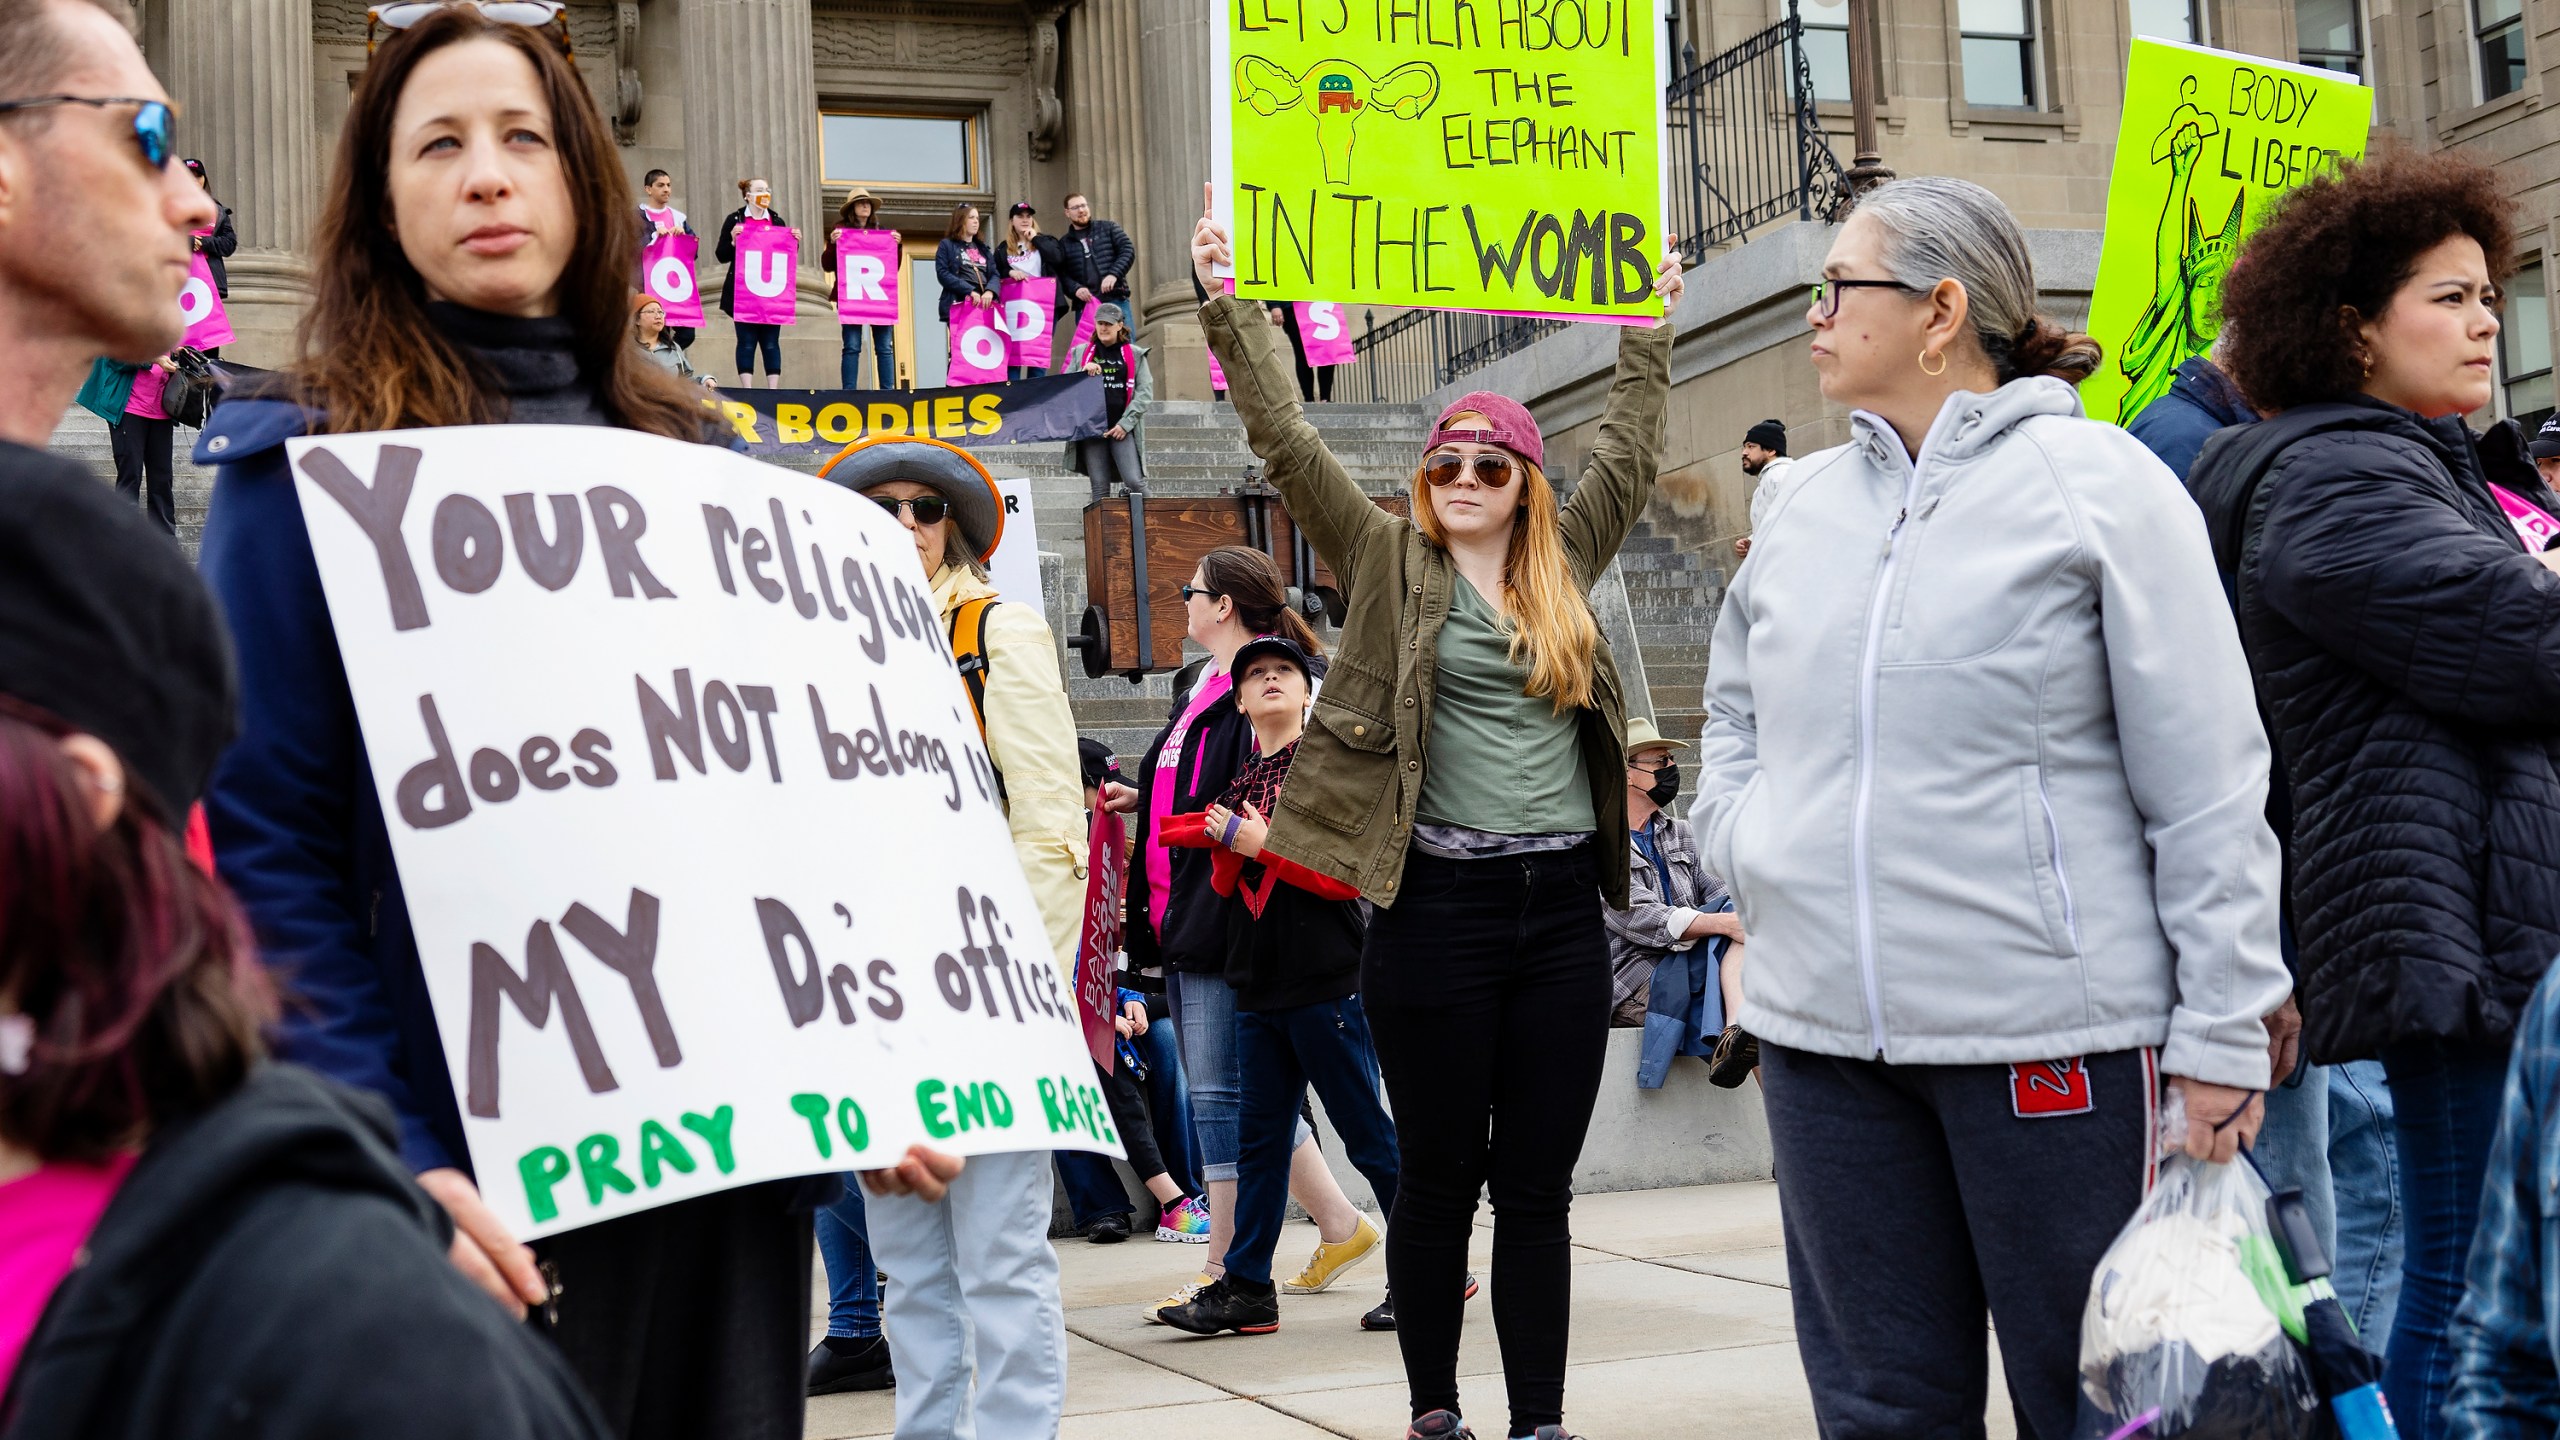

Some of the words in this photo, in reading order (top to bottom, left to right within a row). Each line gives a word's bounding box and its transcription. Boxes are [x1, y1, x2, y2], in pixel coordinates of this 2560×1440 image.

[1474, 68, 1577, 108] THE
[2229, 67, 2318, 128] BODY
[1442, 112, 1636, 177] ELEPHANT
[744, 250, 788, 298] U
[1241, 182, 1317, 287] IN
[1332, 193, 1456, 292] THE
[1462, 203, 1653, 306] WOMB
[650, 257, 694, 303] O
[845, 255, 889, 301] R
[960, 325, 1005, 370] O
[1308, 302, 1341, 341] S
[776, 393, 1003, 444] BODIES
[299, 444, 676, 632] YOUR
[702, 497, 953, 668] religion
[397, 693, 618, 829] does
[635, 668, 784, 784] NOT
[807, 683, 962, 812] belong
[1084, 897, 1100, 1006] BANS
[1094, 935, 1106, 1017] OFF
[1101, 841, 1112, 934] OUR
[1102, 865, 1118, 1024] BODIES
[467, 887, 681, 1118] MY
[755, 896, 904, 1028] Dr's
[518, 1105, 736, 1222] PRAY
[791, 1092, 869, 1159] TO
[916, 1078, 1014, 1139] END
[1036, 1075, 1116, 1144] RAPE
